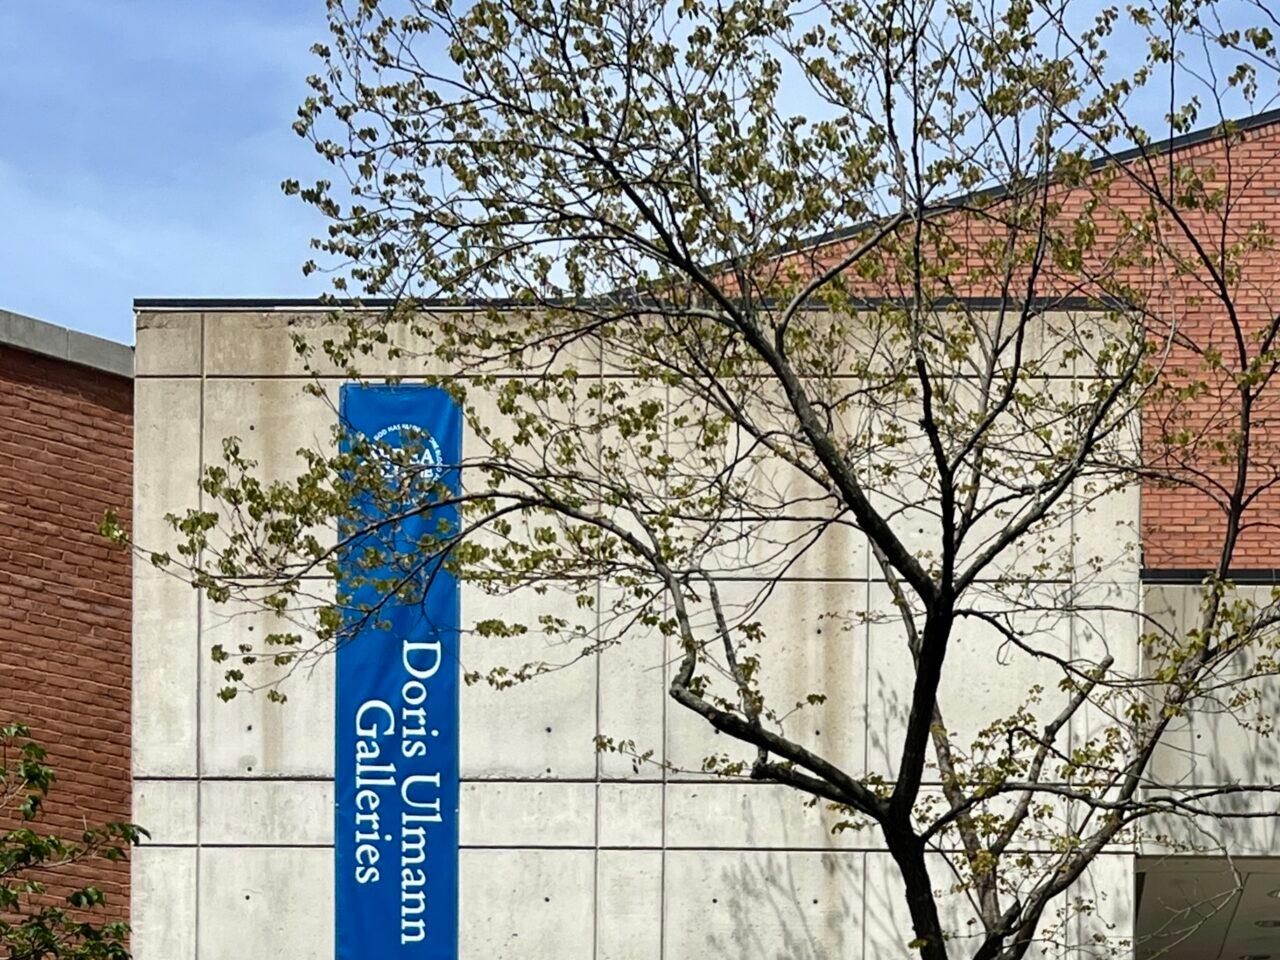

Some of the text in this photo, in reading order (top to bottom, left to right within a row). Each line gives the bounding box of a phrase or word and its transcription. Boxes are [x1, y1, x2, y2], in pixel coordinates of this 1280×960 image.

[355, 699, 396, 885] Galleries
[401, 640, 443, 945] Doris Ulmann
